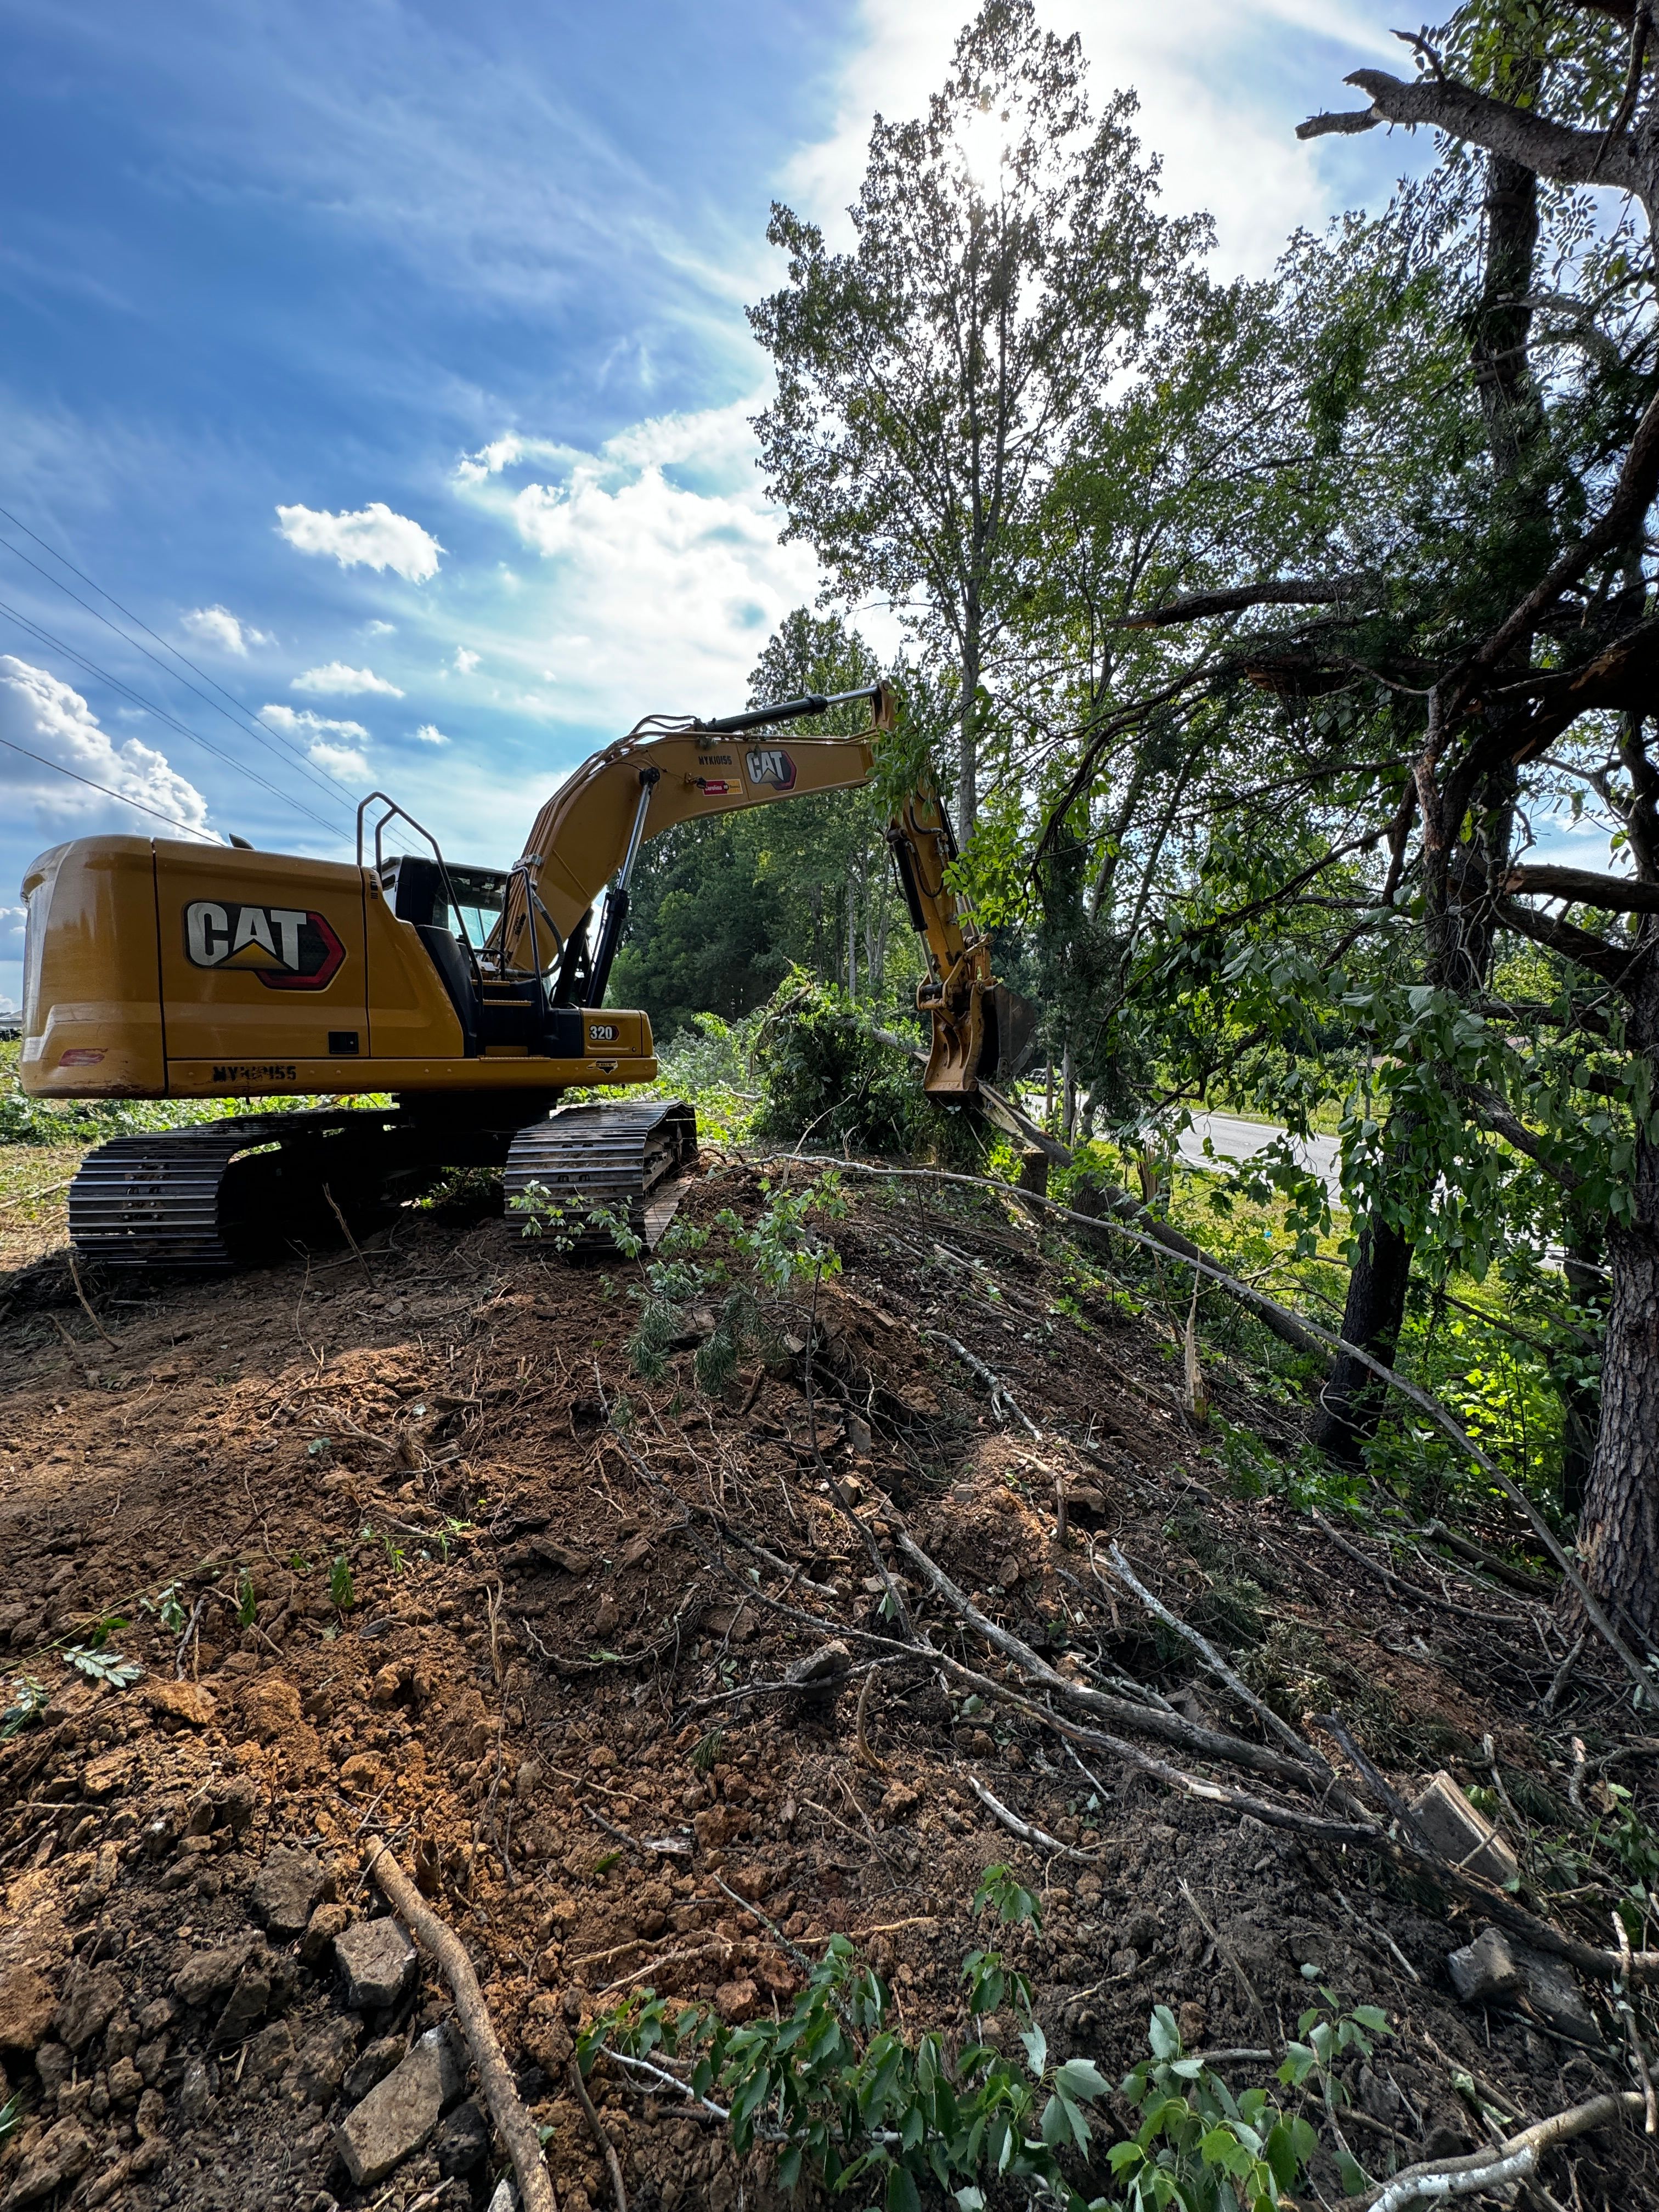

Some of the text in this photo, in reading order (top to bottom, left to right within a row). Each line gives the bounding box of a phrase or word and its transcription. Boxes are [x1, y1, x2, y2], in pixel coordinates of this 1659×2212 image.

[747, 751, 784, 783] CAT
[187, 902, 307, 970] CAT
[590, 1025, 612, 1040] 320
[213, 1065, 297, 1082] MY155
